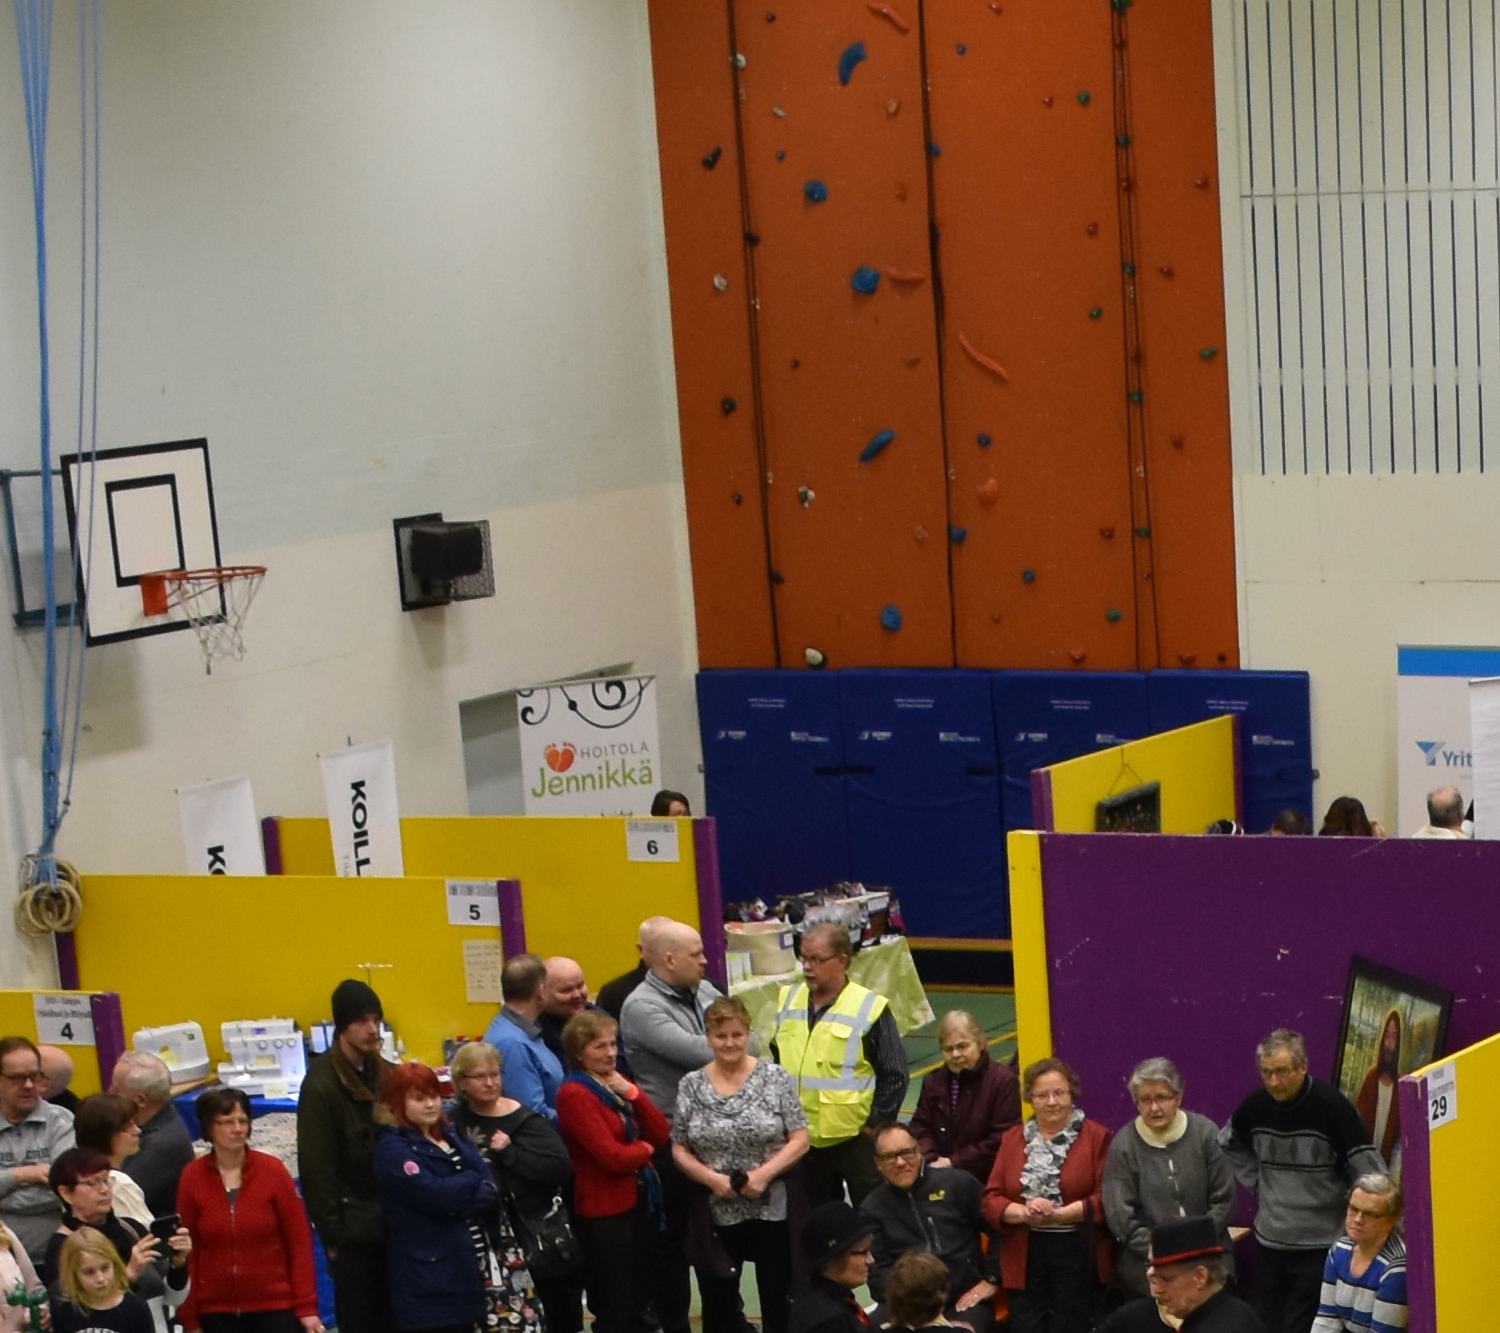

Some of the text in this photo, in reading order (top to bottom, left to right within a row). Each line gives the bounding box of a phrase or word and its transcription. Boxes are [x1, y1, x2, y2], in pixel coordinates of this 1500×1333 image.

[580, 743, 649, 760] HOITOLA
[531, 759, 653, 798] Jennikkä
[646, 839, 659, 856] 6
[207, 845, 226, 876] K
[468, 904, 481, 921] 5
[60, 1022, 74, 1041] 4
[1431, 1095, 1448, 1122] 29
